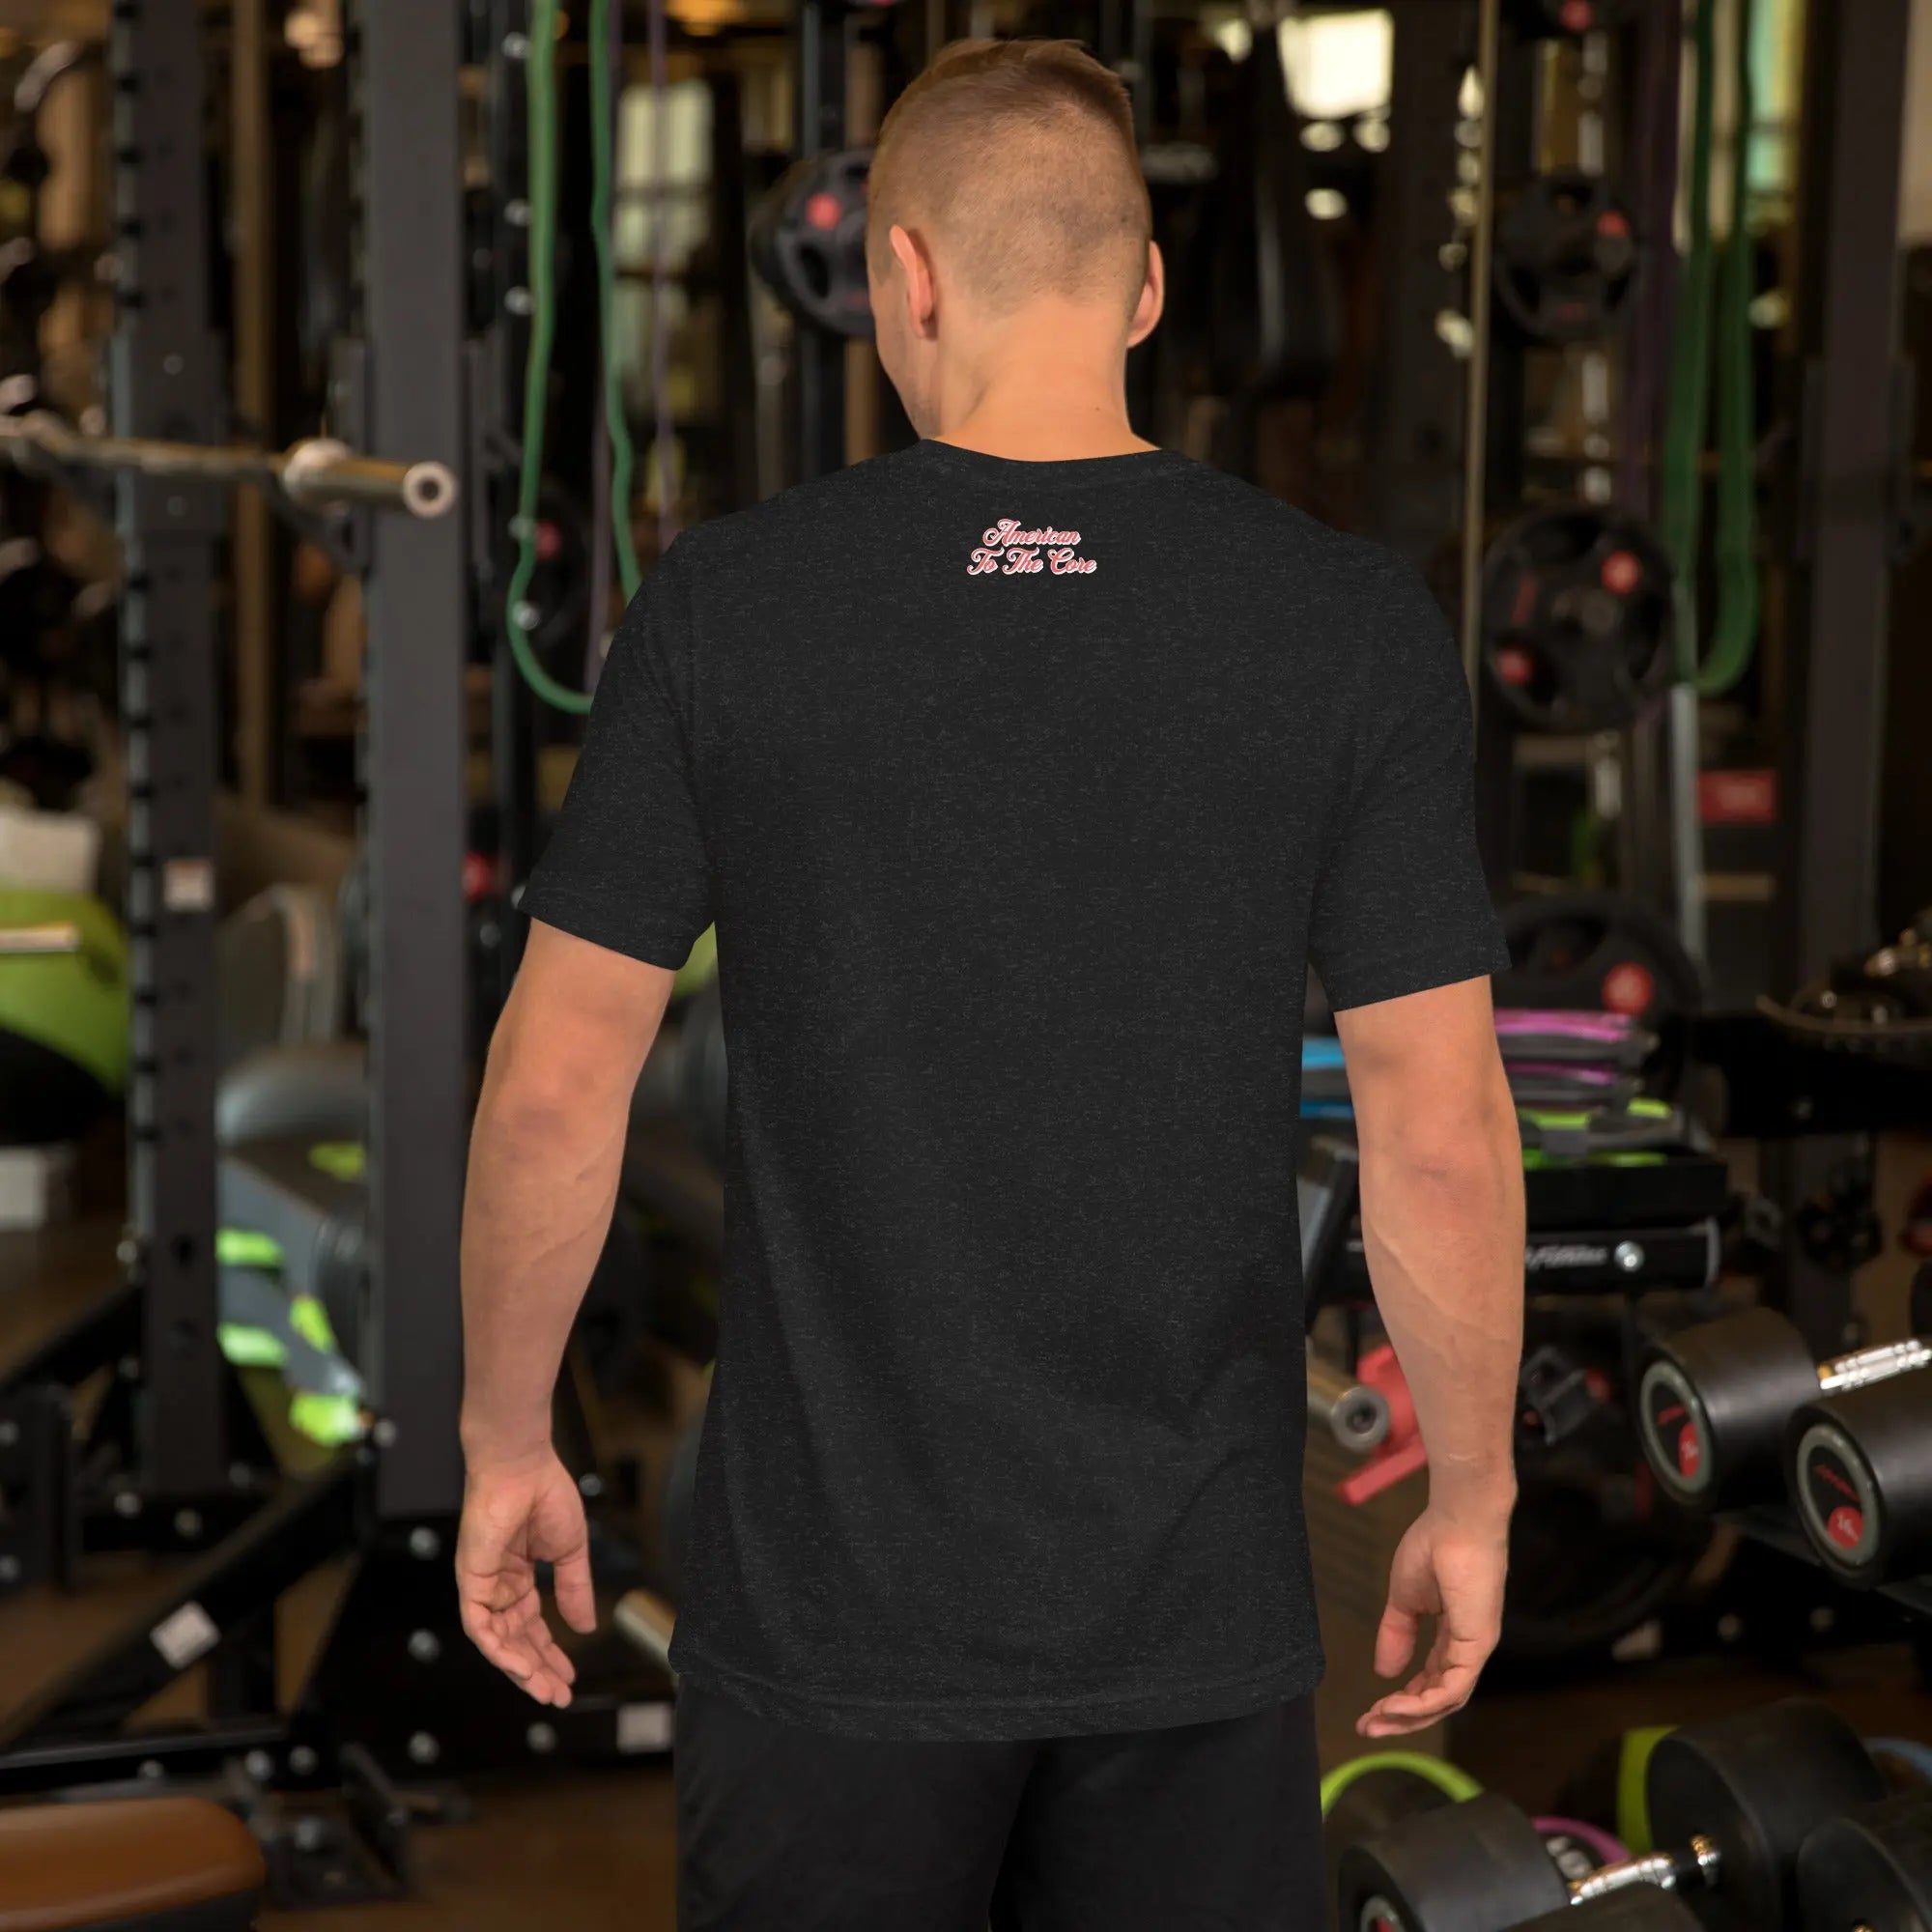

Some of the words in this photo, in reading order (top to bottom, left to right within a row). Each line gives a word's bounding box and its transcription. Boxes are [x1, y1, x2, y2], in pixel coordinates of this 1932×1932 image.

[982, 519, 1081, 547] American
[967, 547, 1005, 575] To
[1002, 547, 1044, 575] The
[1047, 547, 1097, 575] Core
